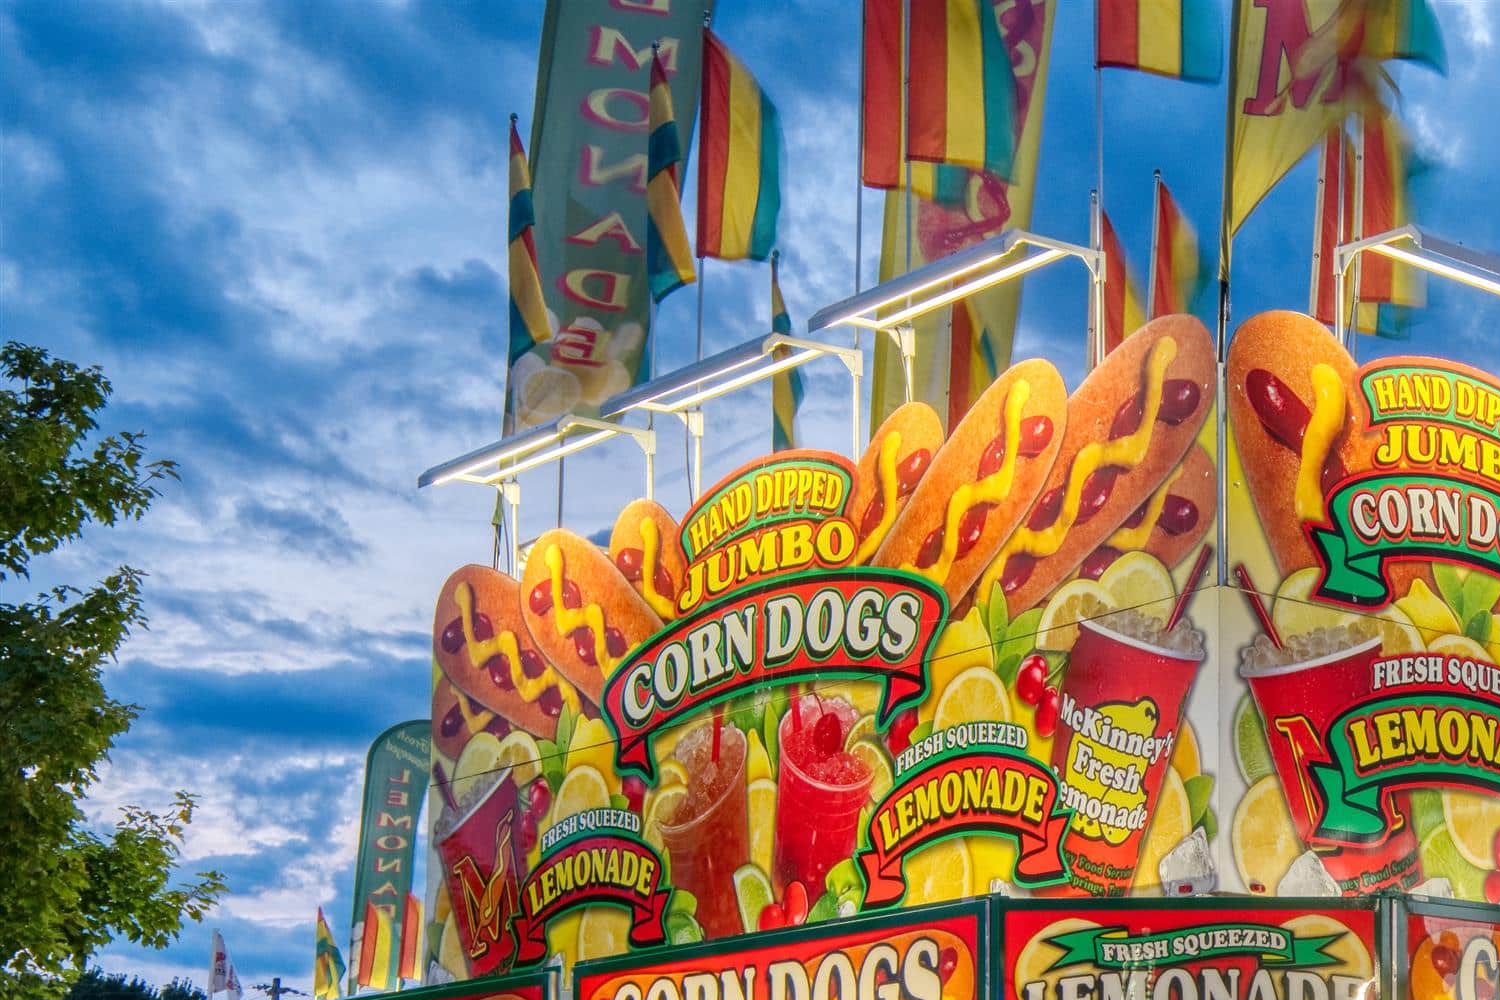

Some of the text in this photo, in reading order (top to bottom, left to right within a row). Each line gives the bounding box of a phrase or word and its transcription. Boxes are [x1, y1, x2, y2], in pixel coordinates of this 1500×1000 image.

[1373, 374, 1450, 416] HAND
[687, 468, 844, 554] HAND DIPPED
[1351, 487, 1464, 539] CORN
[679, 521, 857, 609] JUMBO
[621, 589, 921, 721] CORN DOGS
[1372, 655, 1443, 690] FRESH
[896, 722, 1028, 777] FRESH SQUEEZED
[1060, 693, 1175, 766] McKinney's
[1073, 740, 1141, 794] Fresh
[879, 767, 1050, 851] LEMONADE
[1053, 765, 1149, 830] emonade
[541, 809, 641, 853] FRESH SQUEEZED
[526, 848, 655, 914] LEMONADE
[1101, 928, 1289, 965] FRESH SQUEEZED
